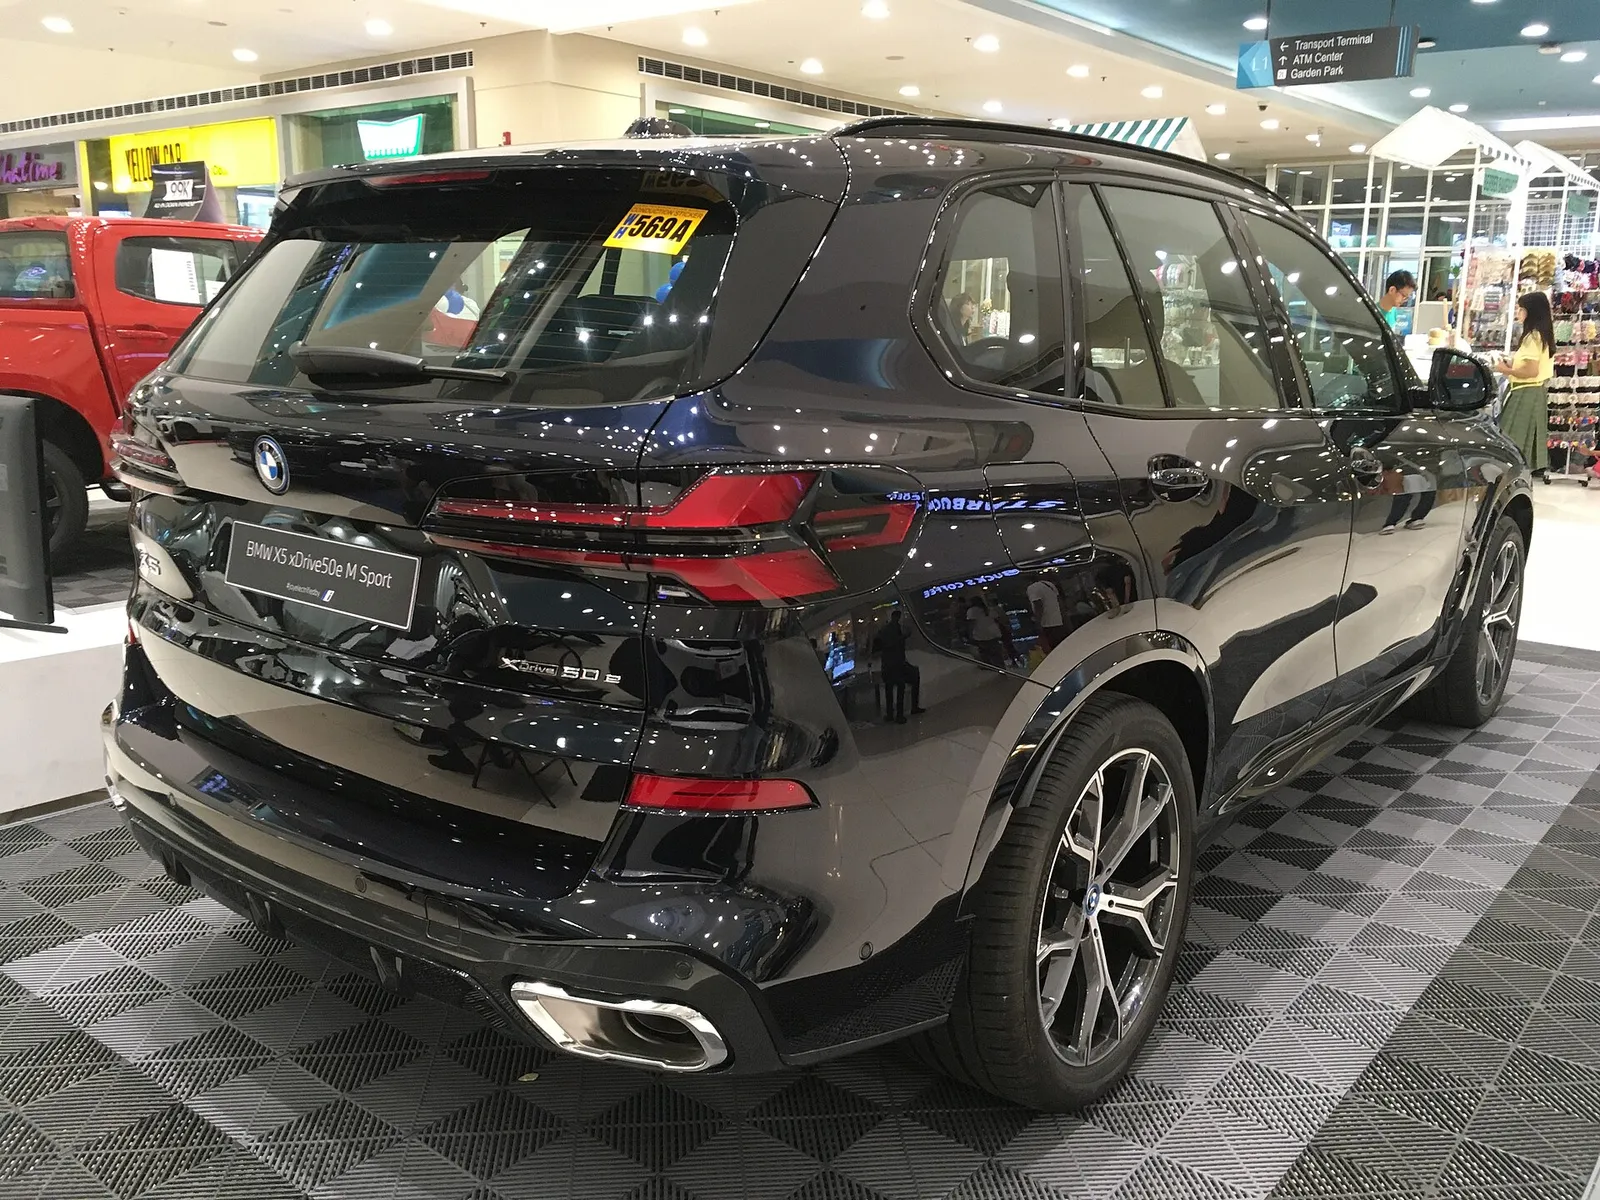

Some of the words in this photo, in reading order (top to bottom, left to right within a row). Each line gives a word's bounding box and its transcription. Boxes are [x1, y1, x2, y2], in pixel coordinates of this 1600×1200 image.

[1295, 37, 1334, 51] Transport
[1337, 33, 1374, 46] Terminal
[1252, 56, 1268, 71] L1
[1292, 54, 1313, 65] ATM
[1314, 51, 1344, 63] Center
[1290, 67, 1322, 79] Garden
[1324, 65, 1344, 77] Park
[0, 152, 62, 184] hatime
[125, 145, 160, 182] YELLOW
[631, 207, 673, 216] CONDUCTION
[674, 210, 704, 220] STICKER
[628, 214, 693, 243] 569A
[246, 540, 273, 562] BMW
[273, 546, 288, 565] X5
[288, 551, 343, 578] xDrive50e
[345, 562, 356, 581] M
[359, 565, 393, 590] Sport
